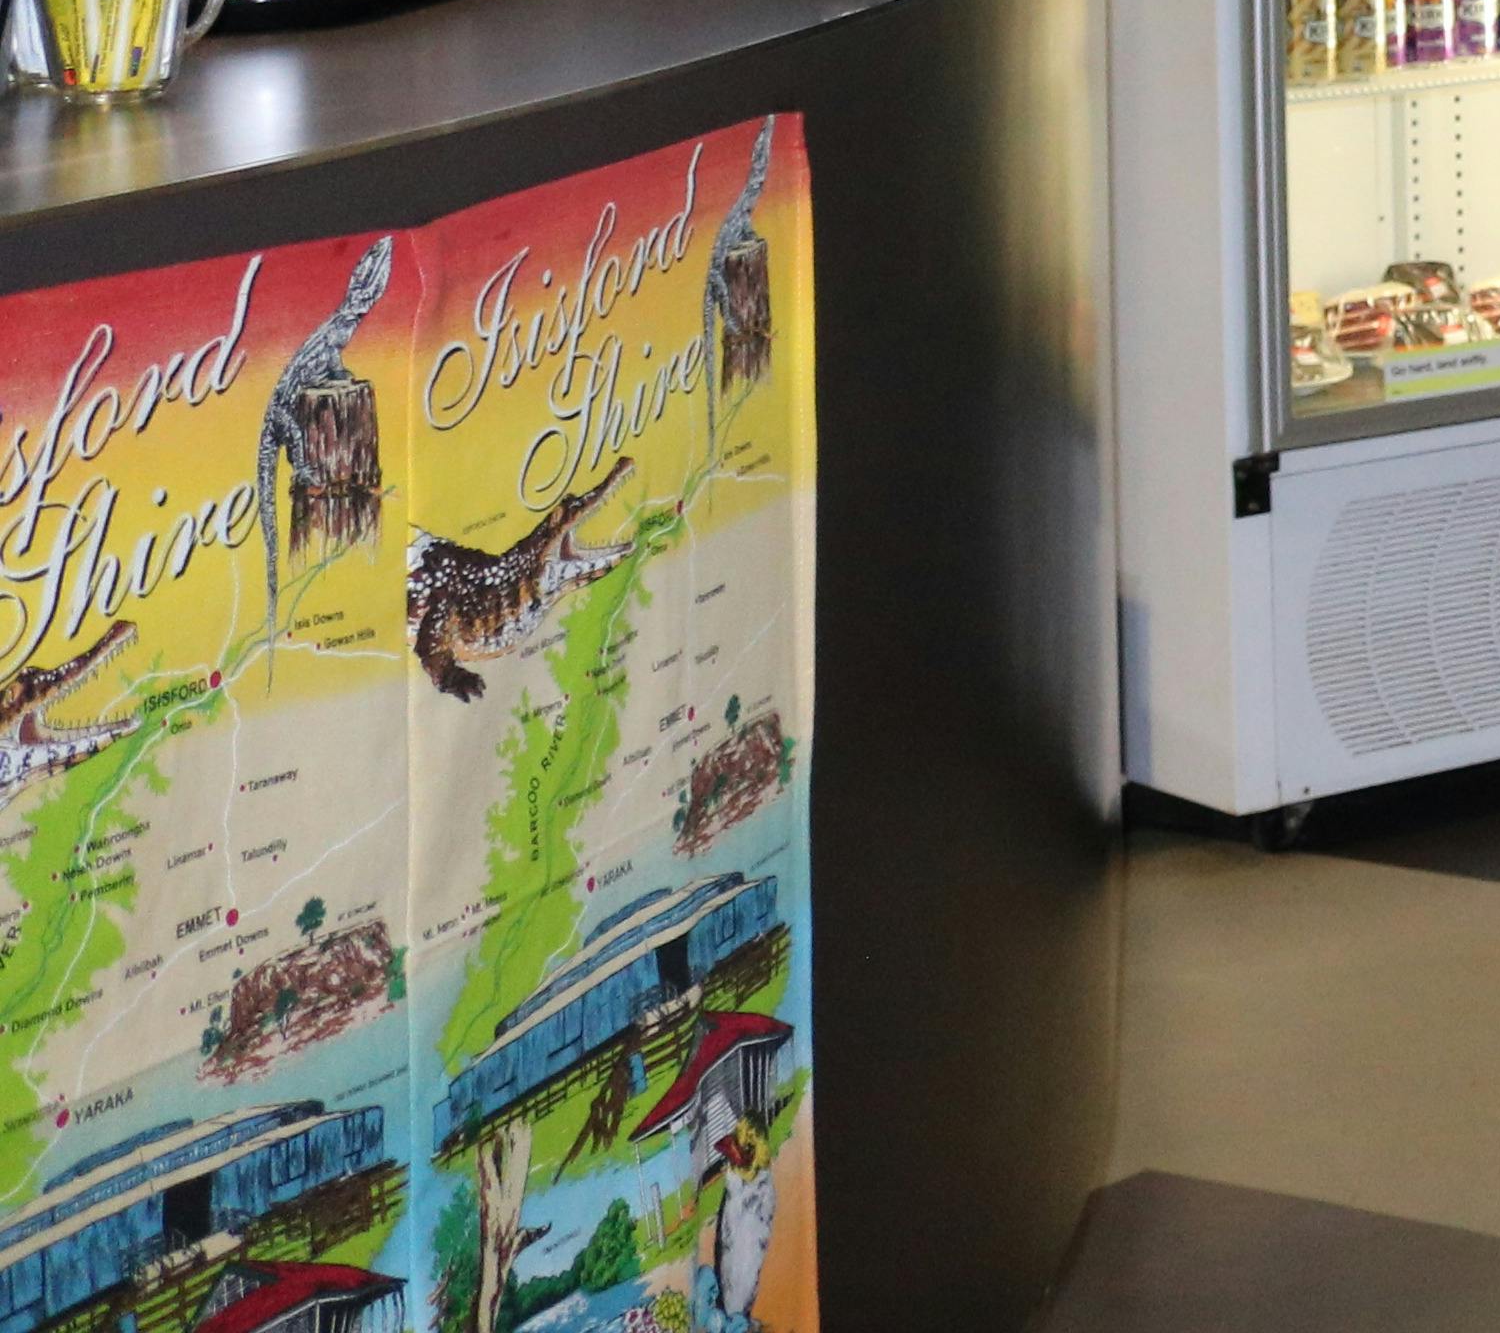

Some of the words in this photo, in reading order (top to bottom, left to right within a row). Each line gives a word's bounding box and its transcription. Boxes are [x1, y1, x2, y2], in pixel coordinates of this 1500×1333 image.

[423, 142, 703, 431] Isisford
[0, 254, 264, 556] sford
[518, 334, 704, 512] Shire
[0, 477, 260, 685] Shire
[143, 677, 208, 714] ISISFORD
[527, 776, 542, 862] BARCOO
[540, 713, 568, 772] RIVER
[175, 906, 223, 940] EMMET
[199, 940, 233, 963] Emmet
[236, 927, 270, 948] Downs
[11, 1003, 63, 1034] Diamond
[66, 988, 104, 1012] Downs
[74, 1086, 135, 1126] YARAKA
